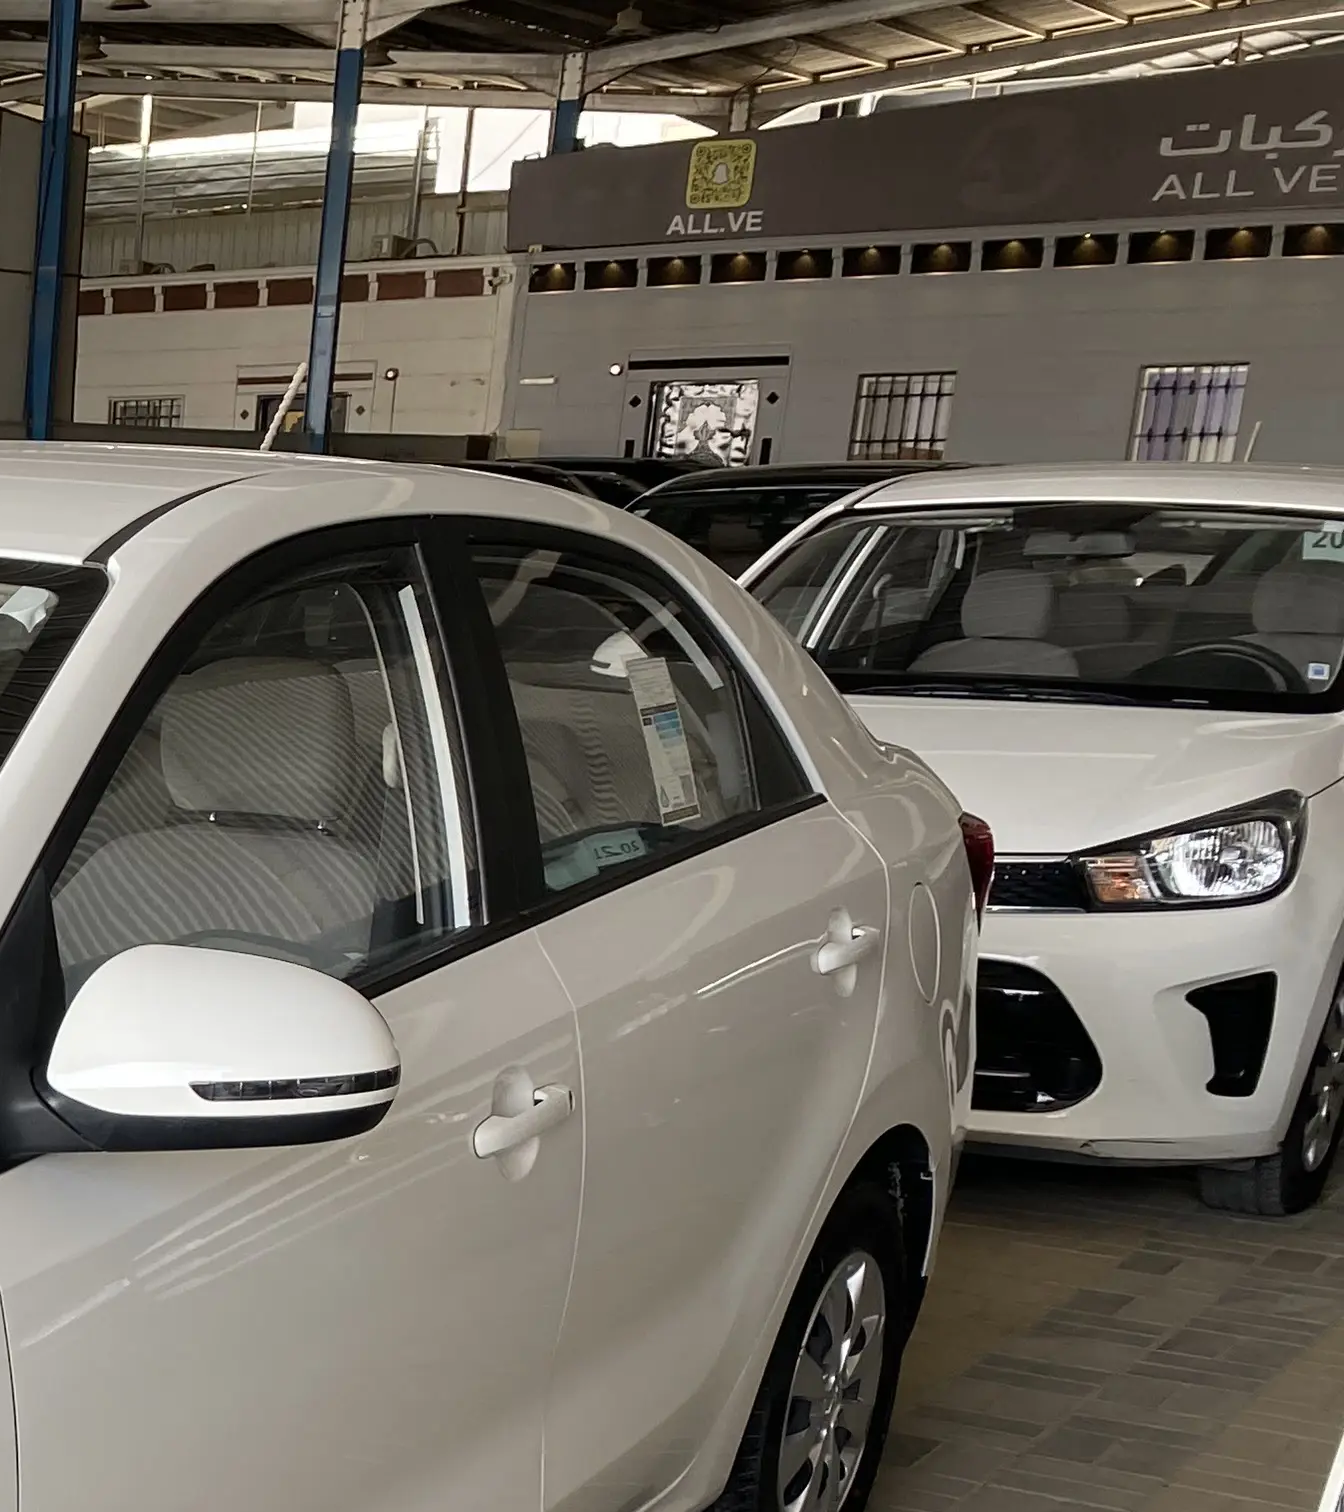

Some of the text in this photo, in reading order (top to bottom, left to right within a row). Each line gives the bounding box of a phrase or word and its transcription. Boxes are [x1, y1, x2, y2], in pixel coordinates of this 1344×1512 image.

[1151, 164, 1341, 202] ALL VE
[665, 210, 765, 236] ALL.VE
